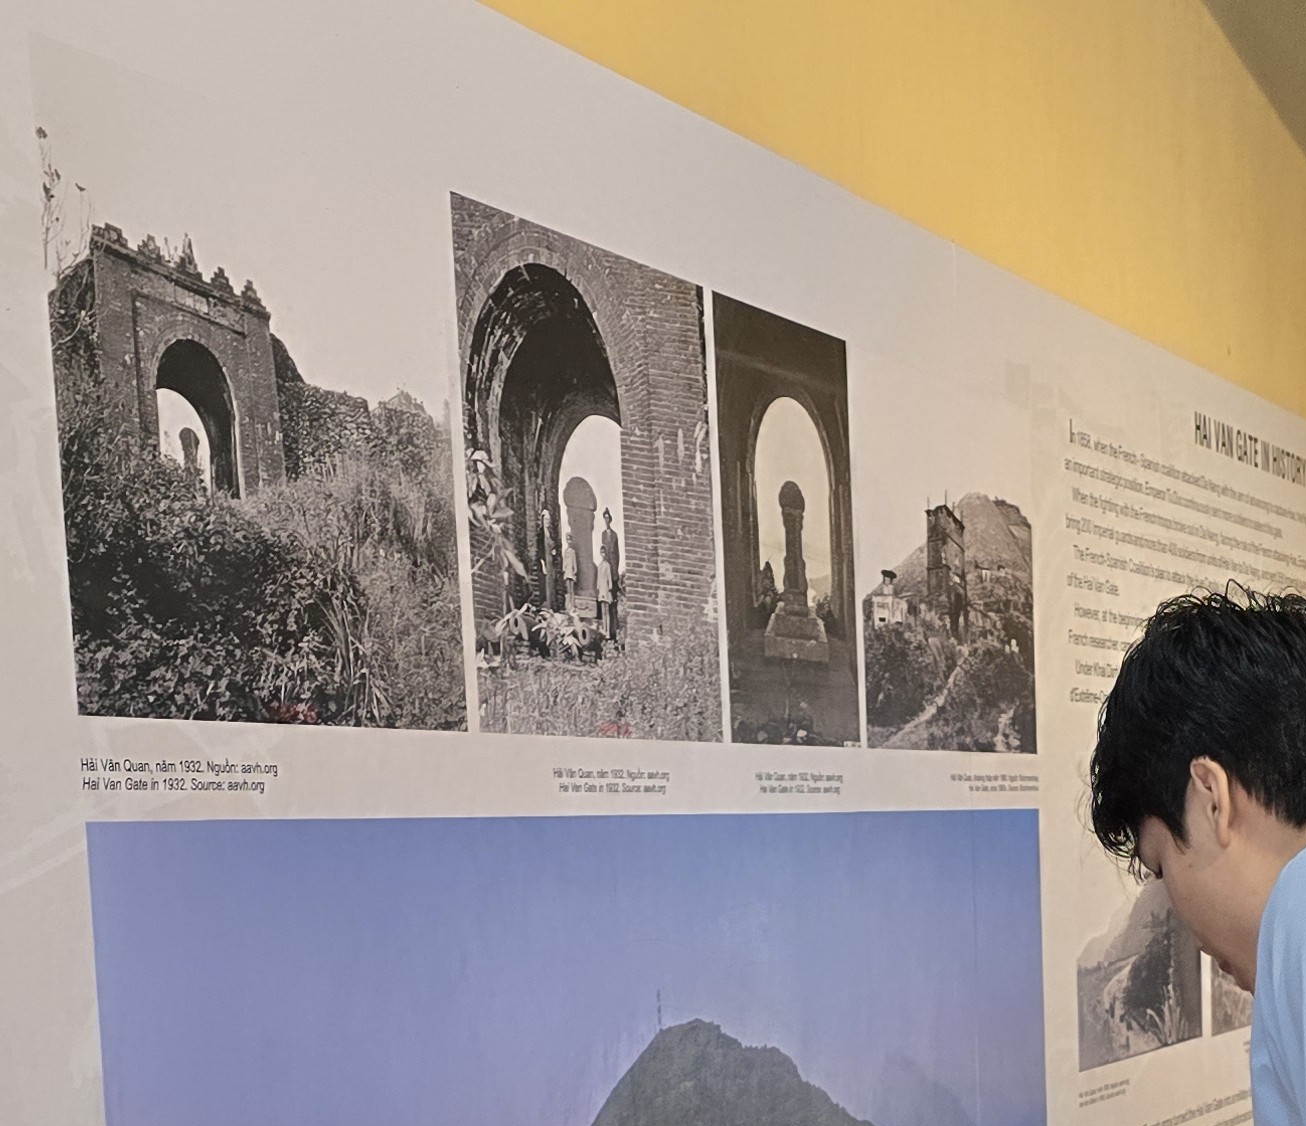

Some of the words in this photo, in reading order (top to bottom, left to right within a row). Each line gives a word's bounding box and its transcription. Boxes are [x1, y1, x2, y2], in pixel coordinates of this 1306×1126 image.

[1194, 411, 1212, 449] HAI
[1213, 419, 1234, 459] VAN
[1235, 429, 1259, 468] GATE
[1260, 440, 1270, 473] IN
[80, 757, 98, 772] Hải
[101, 758, 121, 772] Vân
[123, 759, 153, 774] Quan,
[155, 759, 177, 773] năm
[179, 760, 204, 774] 1932.
[207, 759, 238, 776] Nguồn:
[241, 762, 278, 777] aavh.org
[82, 777, 99, 791] Hai
[102, 777, 121, 791] Van
[125, 777, 148, 791] Gate
[150, 777, 159, 791] in
[162, 777, 187, 792] 1932.
[190, 778, 225, 791] Source:
[227, 779, 265, 794] aavh.org
